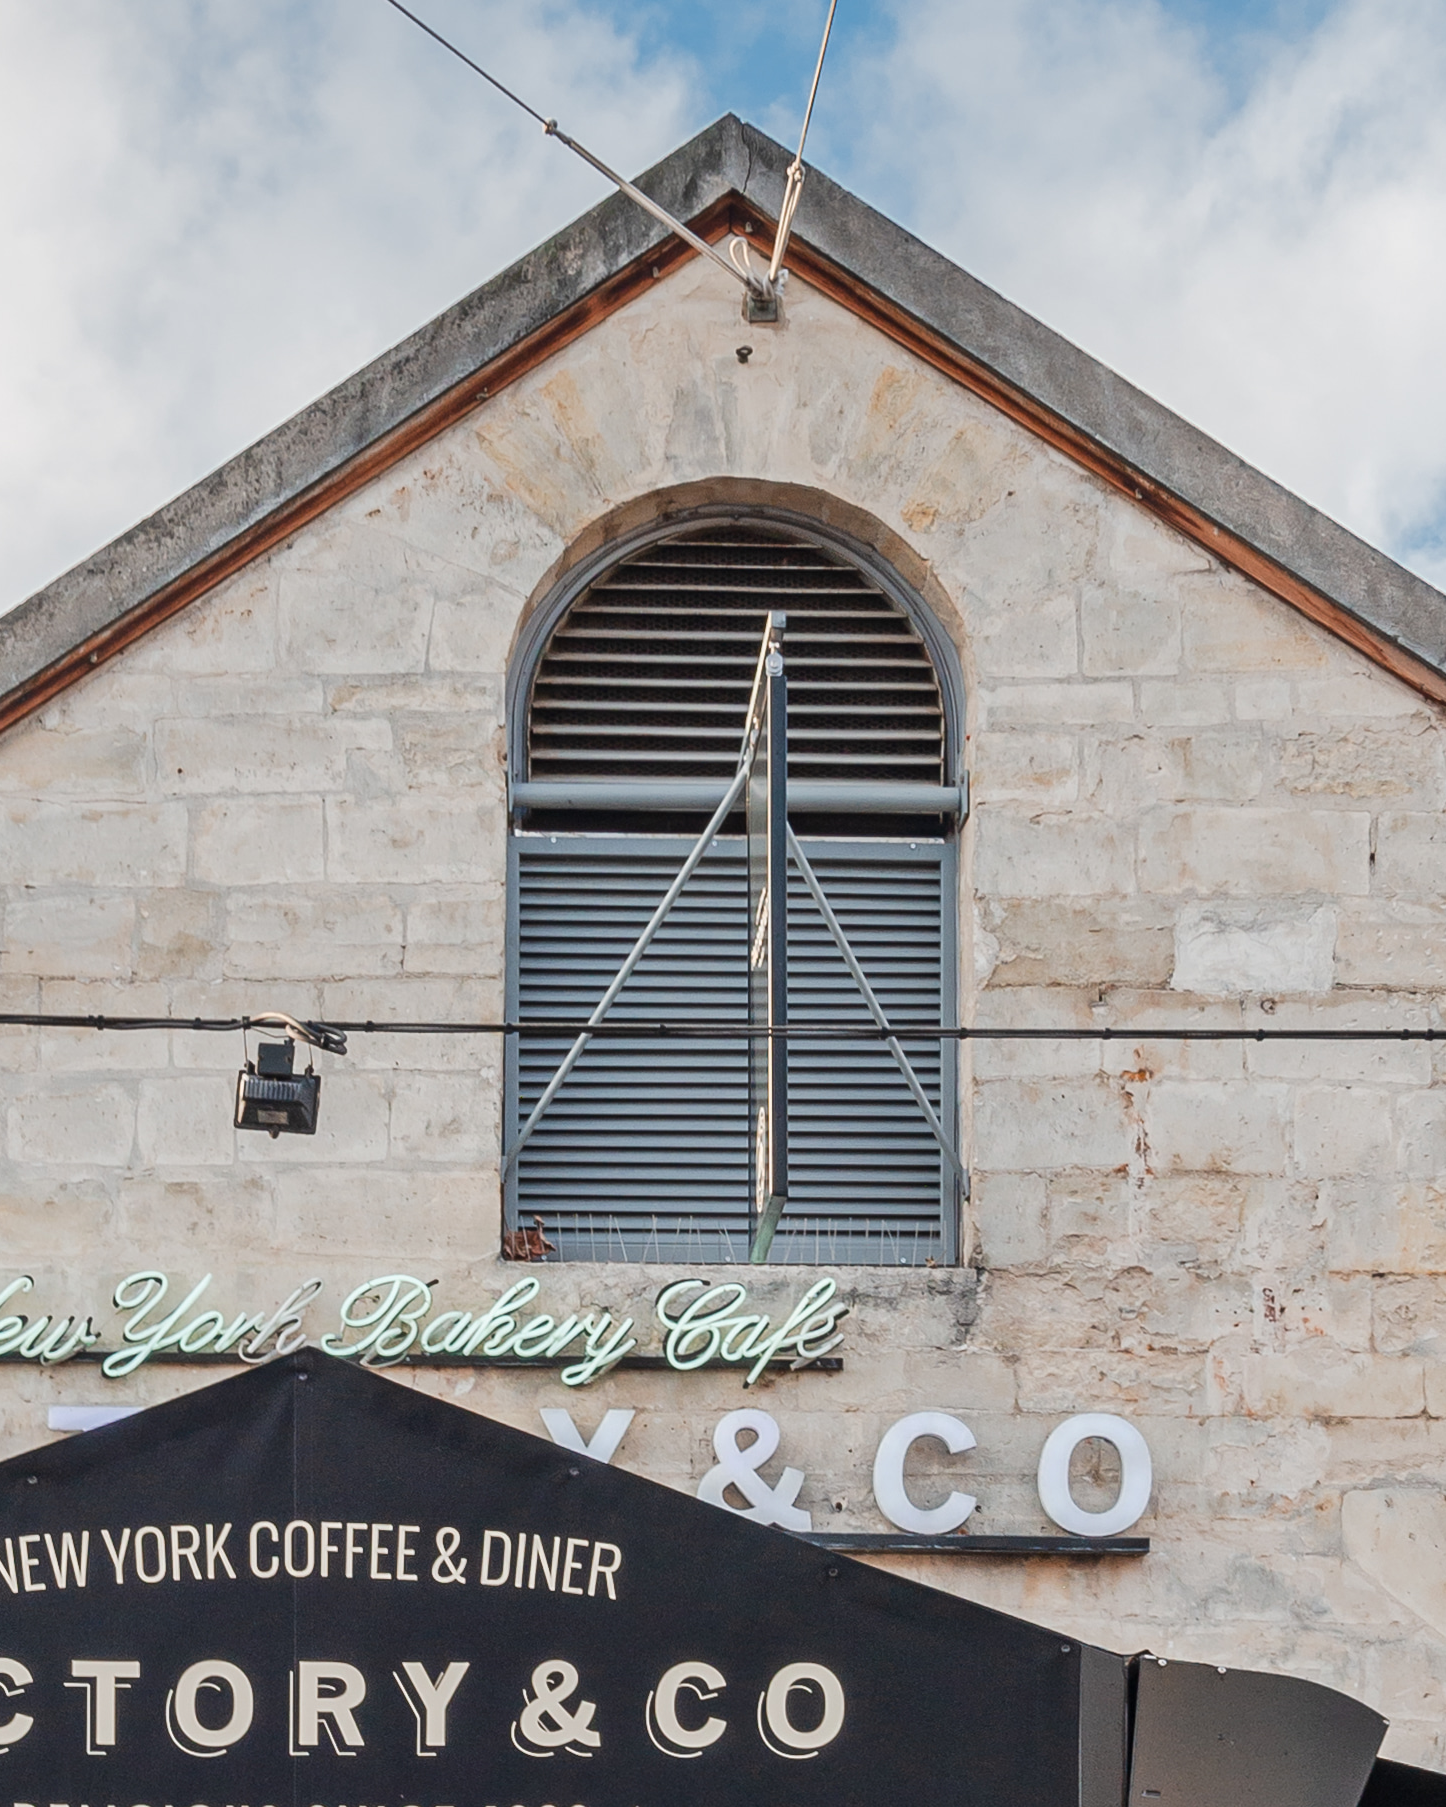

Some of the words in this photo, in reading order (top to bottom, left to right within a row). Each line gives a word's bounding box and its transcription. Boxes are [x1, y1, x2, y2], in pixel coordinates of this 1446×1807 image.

[101, 1271, 326, 1378] York
[324, 1273, 636, 1386] Bakery
[696, 1408, 813, 1532] &
[873, 1410, 1153, 1536] CO
[100, 1523, 237, 1583] YORK
[249, 1520, 420, 1580] COFFEE
[431, 1526, 467, 1584] &
[480, 1529, 622, 1599] DINER
[511, 1659, 601, 1757] &
[646, 1660, 845, 1759] CO
